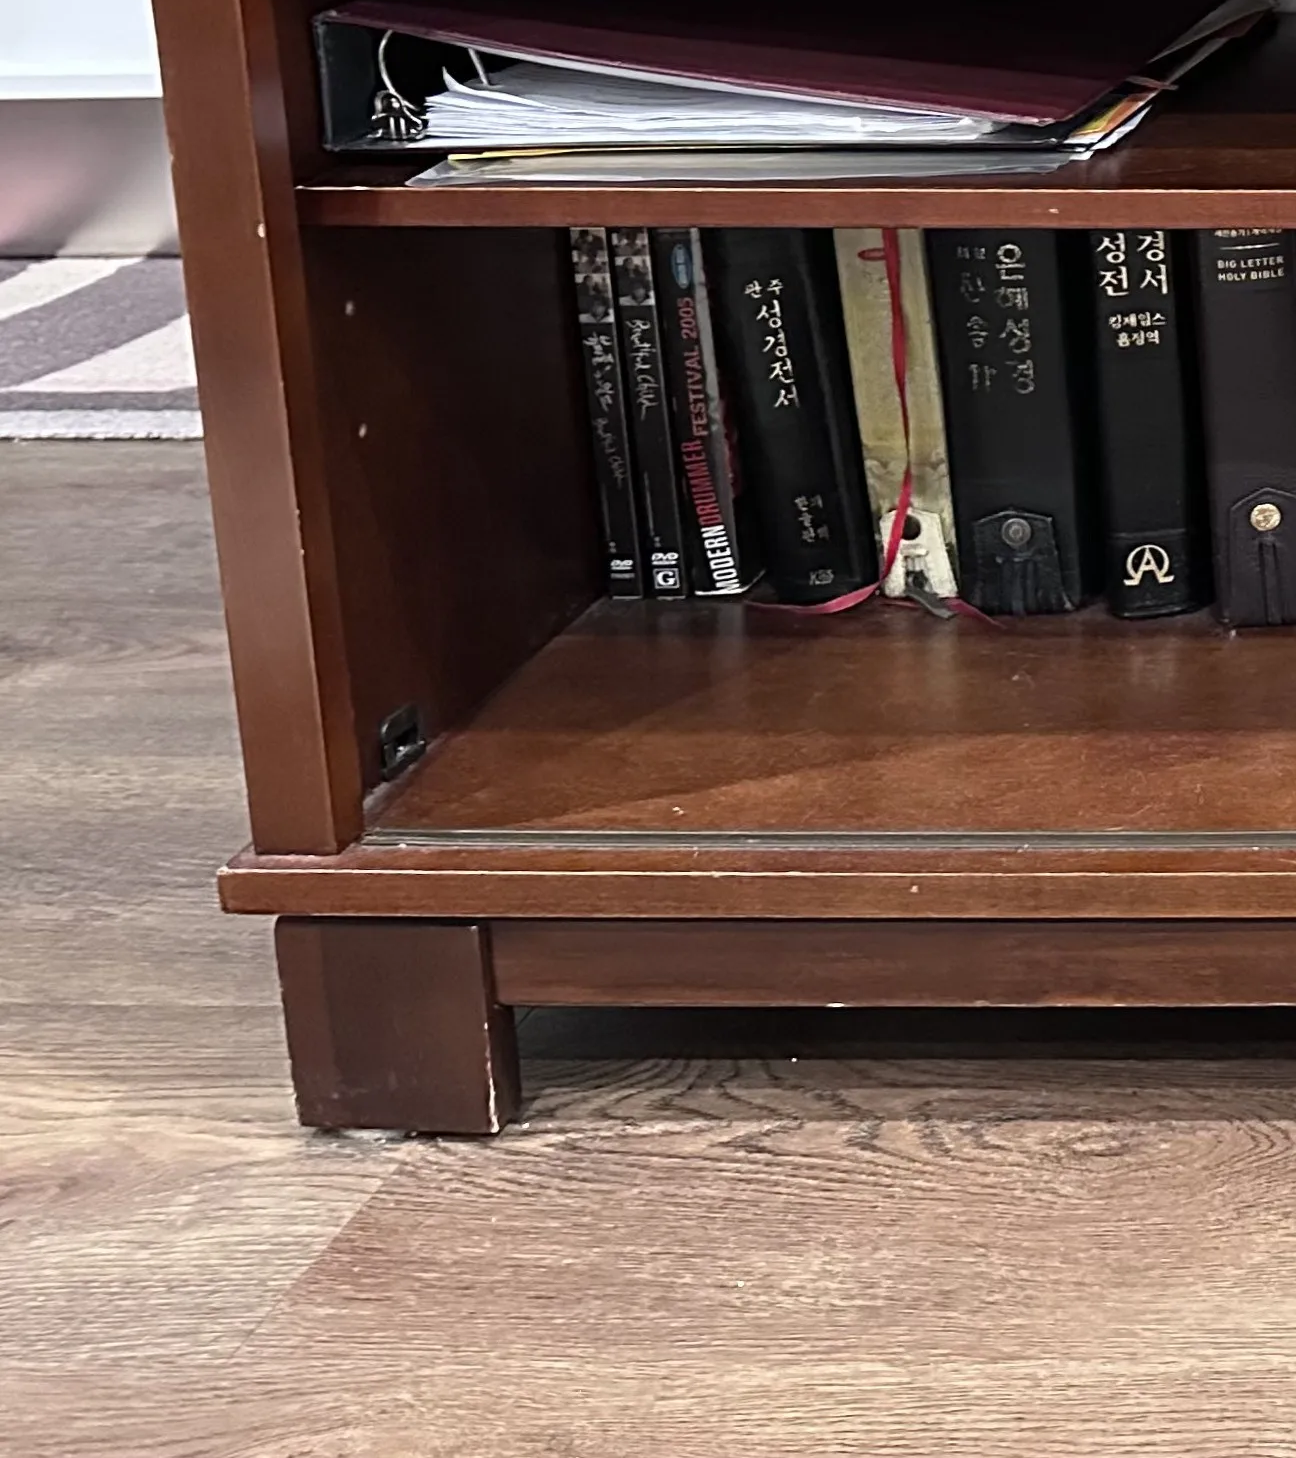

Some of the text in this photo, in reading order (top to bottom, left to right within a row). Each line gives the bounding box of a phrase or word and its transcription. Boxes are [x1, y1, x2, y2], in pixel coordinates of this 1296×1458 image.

[1096, 230, 1165, 264] 성경
[1217, 255, 1285, 270] BIG LETTER
[744, 279, 784, 298] 관주
[1099, 264, 1168, 296] 전서
[1217, 268, 1285, 282] HOLY BIBLE
[676, 297, 698, 339] 2005
[994, 244, 1036, 394] 은혜성경
[1108, 311, 1167, 329] 킹제임스
[756, 299, 800, 408] 성경전서
[1116, 329, 1160, 347] 흠정역
[684, 345, 709, 437] FESTIVAL
[681, 440, 723, 526] DRUMMER
[651, 552, 679, 565] DVD
[700, 524, 741, 593] MODERN
[656, 571, 676, 586] G
